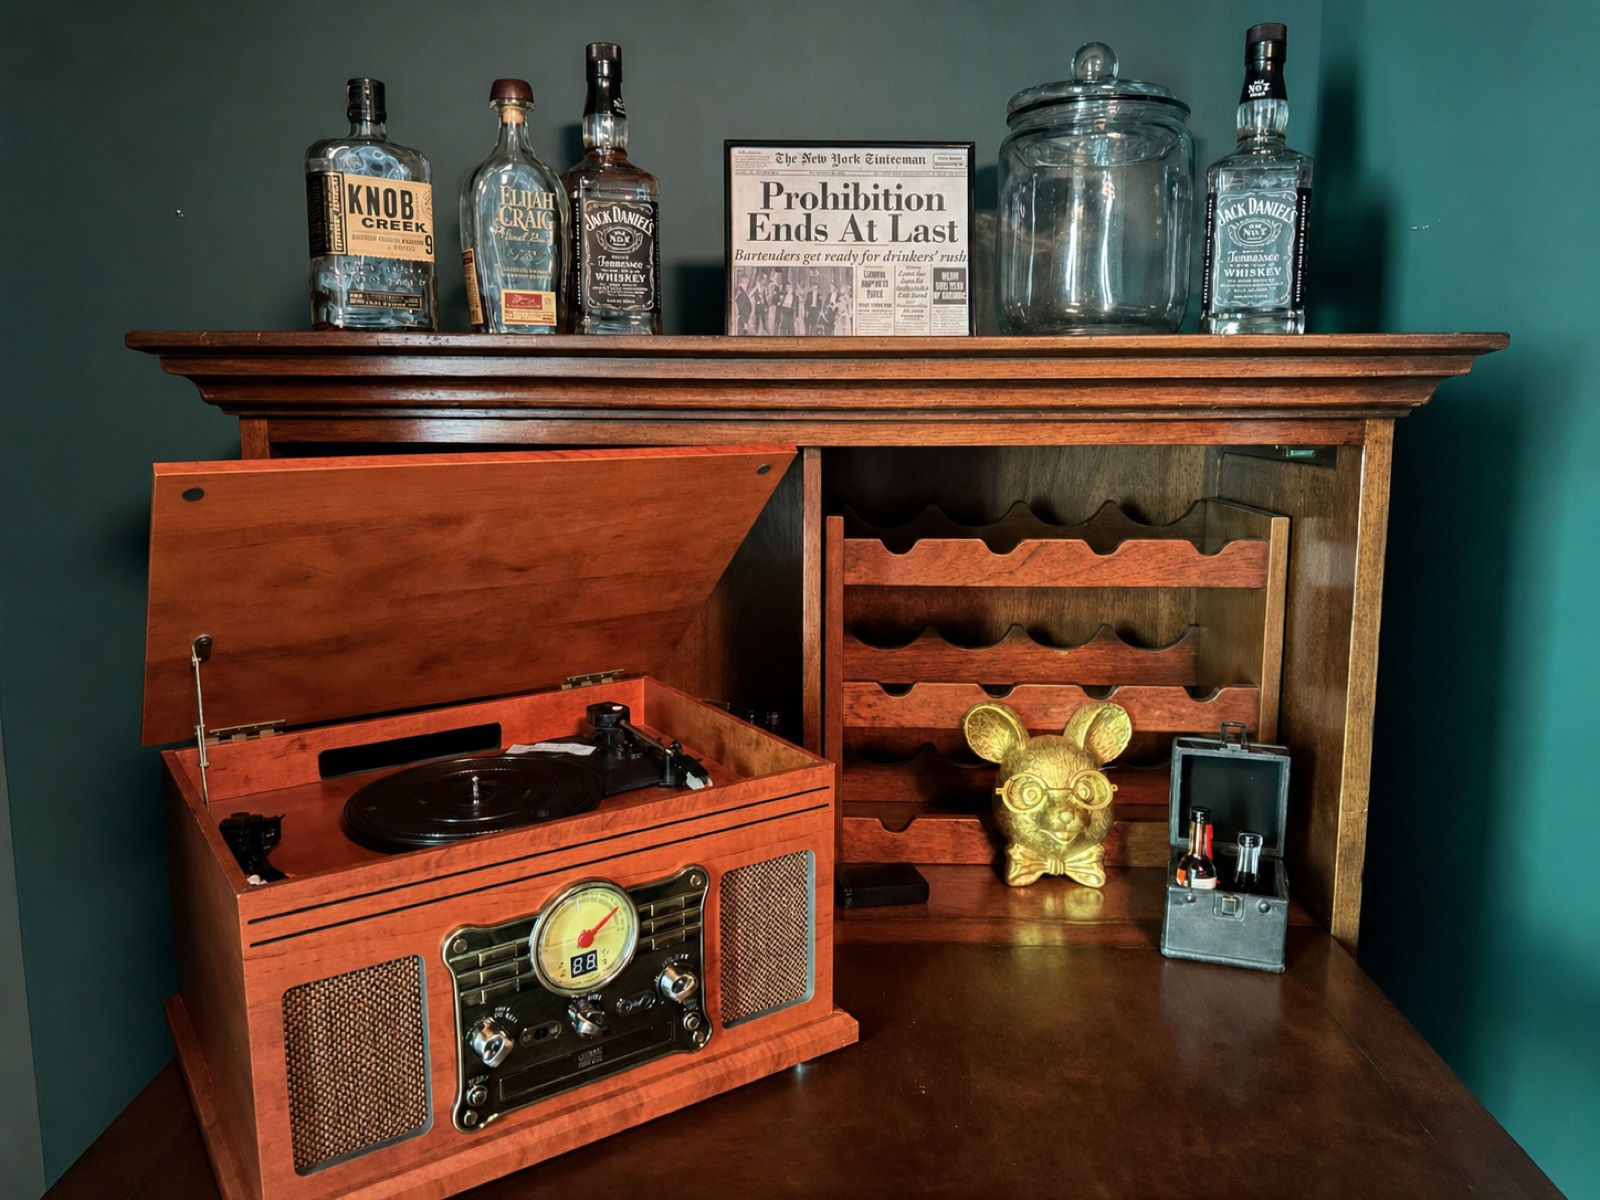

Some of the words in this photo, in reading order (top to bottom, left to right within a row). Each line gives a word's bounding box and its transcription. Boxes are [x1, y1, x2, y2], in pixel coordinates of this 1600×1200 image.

[775, 152, 798, 167] The
[801, 152, 827, 166] New
[831, 153, 861, 168] York
[348, 183, 414, 220] KNOB
[500, 185, 555, 211] ELIJAH
[759, 181, 947, 212] Prohibition
[499, 206, 555, 231] CRAIG
[584, 209, 612, 231] JACK
[612, 206, 655, 236] DANIEL'S
[1216, 202, 1247, 227] JACK
[1248, 197, 1298, 223] DANIEL'S
[361, 217, 428, 233] CREEK
[747, 212, 829, 242] Ends
[838, 213, 878, 243] At
[888, 213, 959, 243] Last
[424, 234, 433, 255] 9
[735, 249, 800, 262] Bartenders
[803, 251, 821, 265] get
[824, 250, 859, 266] ready
[858, 249, 880, 266] for
[882, 249, 938, 263] drinkers'
[940, 250, 967, 262] rush
[595, 272, 646, 283] WHISKEY
[1224, 266, 1282, 277] WHISKEY
